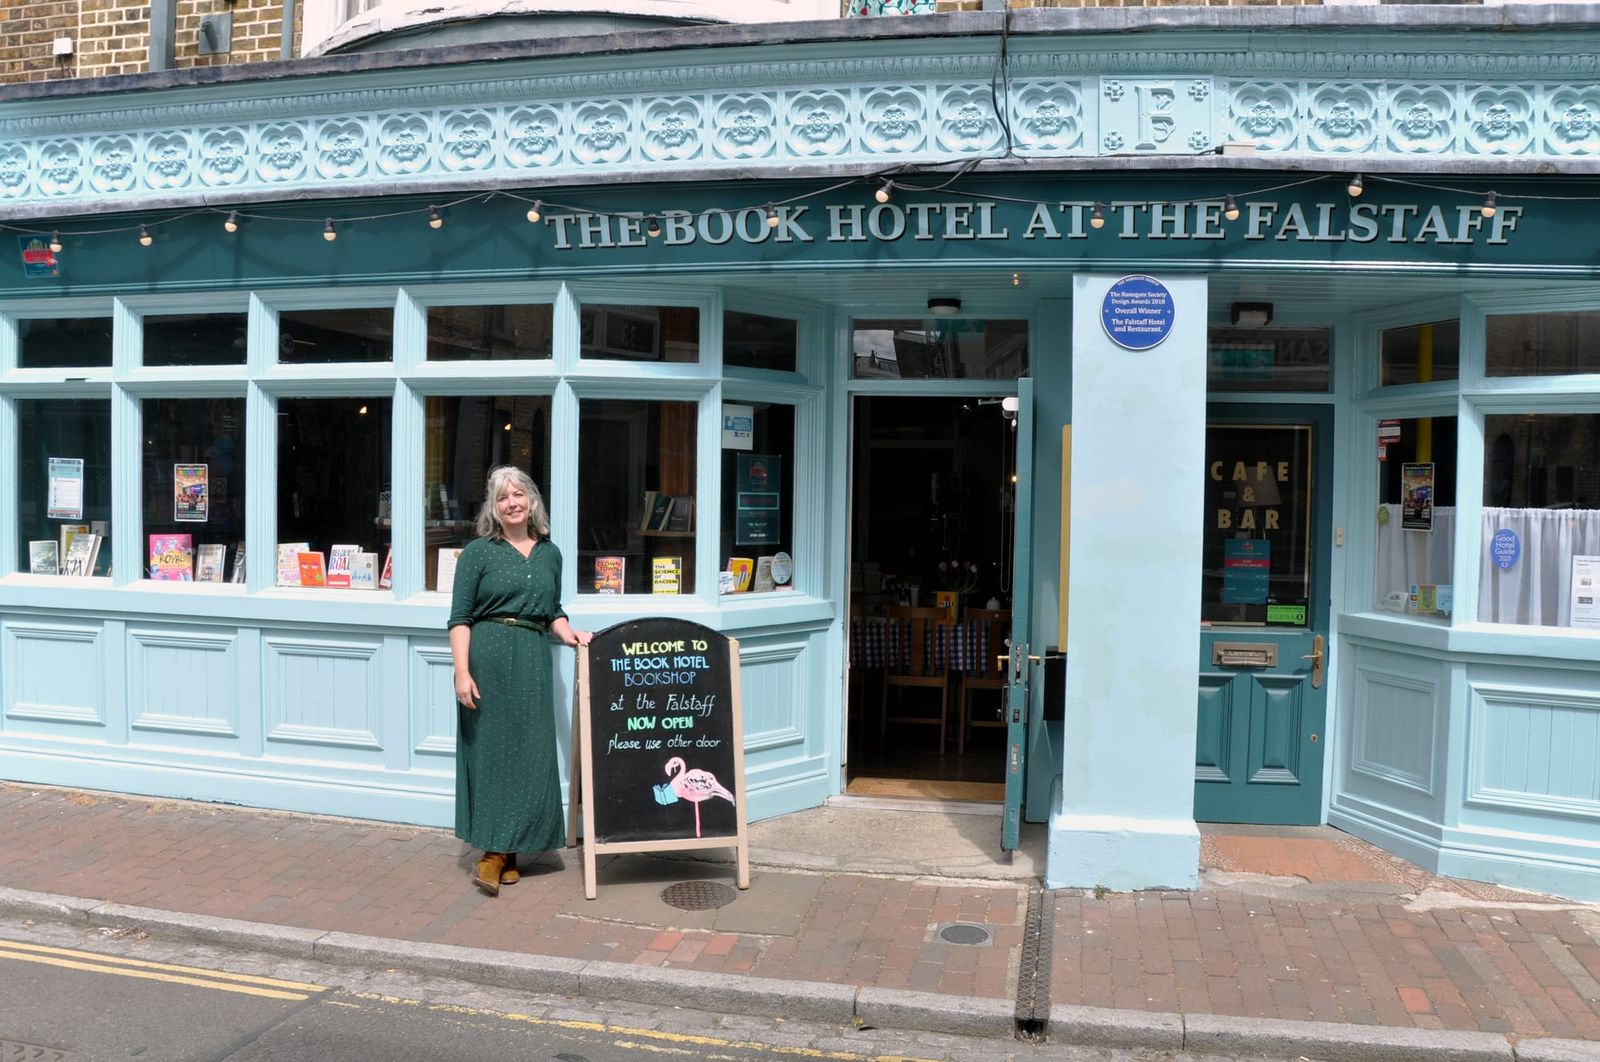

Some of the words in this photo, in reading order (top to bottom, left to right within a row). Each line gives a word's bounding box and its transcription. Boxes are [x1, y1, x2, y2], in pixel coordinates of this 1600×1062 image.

[544, 211, 648, 249] THE
[660, 205, 814, 245] BOOK
[825, 202, 1009, 241] HOTEL
[1022, 201, 1096, 239] AT
[1111, 200, 1226, 239] THE
[1243, 201, 1523, 244] FALSTAFF
[1111, 298, 1130, 306] Design
[1121, 291, 1147, 299] Ramsgate
[1147, 291, 1168, 299] Society
[1210, 460, 1289, 482] CAFE
[1242, 486, 1255, 502] &
[1217, 508, 1280, 529] BAR
[159, 554, 185, 564] ROYAL
[1494, 547, 1516, 555] Guide
[622, 641, 686, 656] WELCOME
[691, 639, 708, 651] TO
[610, 658, 632, 672] THE
[633, 656, 670, 670] BOOK
[673, 655, 710, 669] HOTEL
[624, 671, 697, 687] BOOKSHOP
[610, 693, 625, 711] at
[636, 693, 656, 710] the
[666, 693, 716, 717] Falstaff
[627, 716, 657, 731] NOW
[661, 716, 694, 729] OPEN
[605, 733, 642, 755] please
[645, 739, 661, 750] use
[667, 734, 693, 748] other
[695, 734, 721, 748] door
